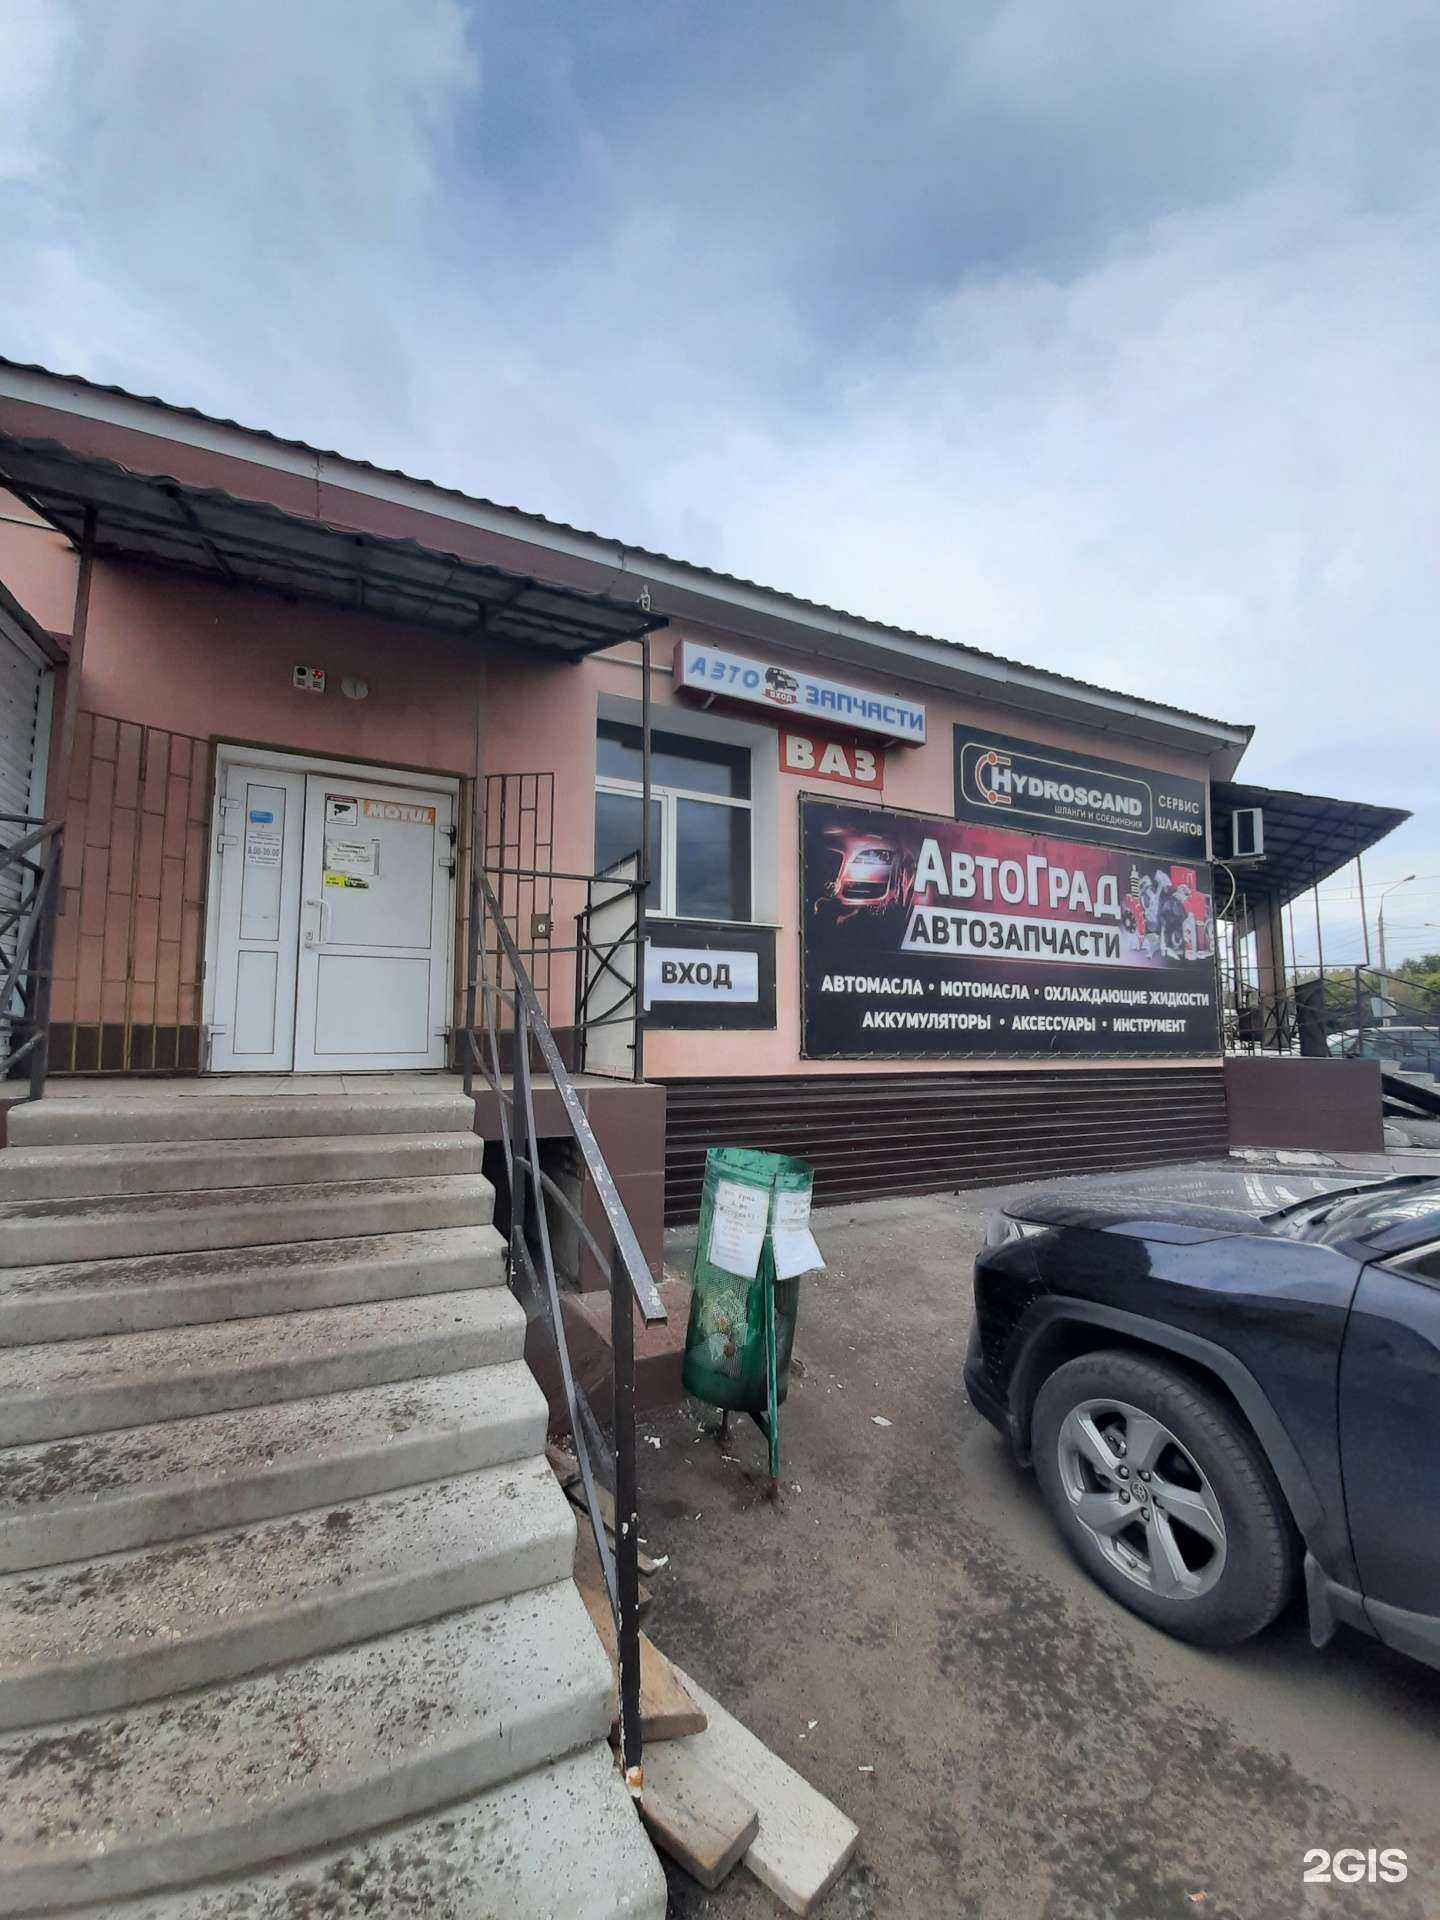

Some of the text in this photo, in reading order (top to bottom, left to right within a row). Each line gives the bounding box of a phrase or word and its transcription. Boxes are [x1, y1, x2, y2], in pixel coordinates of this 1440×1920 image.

[805, 685, 923, 731] ЗАПЧАСТИ
[786, 735, 876, 782] ВАЗ
[991, 766, 1142, 816] HYDROSCAND
[1158, 795, 1200, 815] СЕРВИС
[1054, 805, 1086, 819] ШЛАНГИ
[1096, 813, 1142, 829] СОЕДИНЕНИЯ
[1155, 816, 1202, 836] ШЛАНГОВ
[909, 914, 1121, 959] АВТОЗАПЧАСТИ
[661, 961, 732, 989] ВХОД
[821, 975, 1210, 1007] АВТОМАСЛА МОТОМАСЛА ОХЛАЖДАЮЩИЕ ЖИДКОСТИ
[862, 1010, 1187, 1034] АККУМУЛЯТОРЫ АКСЕССУАРЫ ИНСТРУМЕНТ
